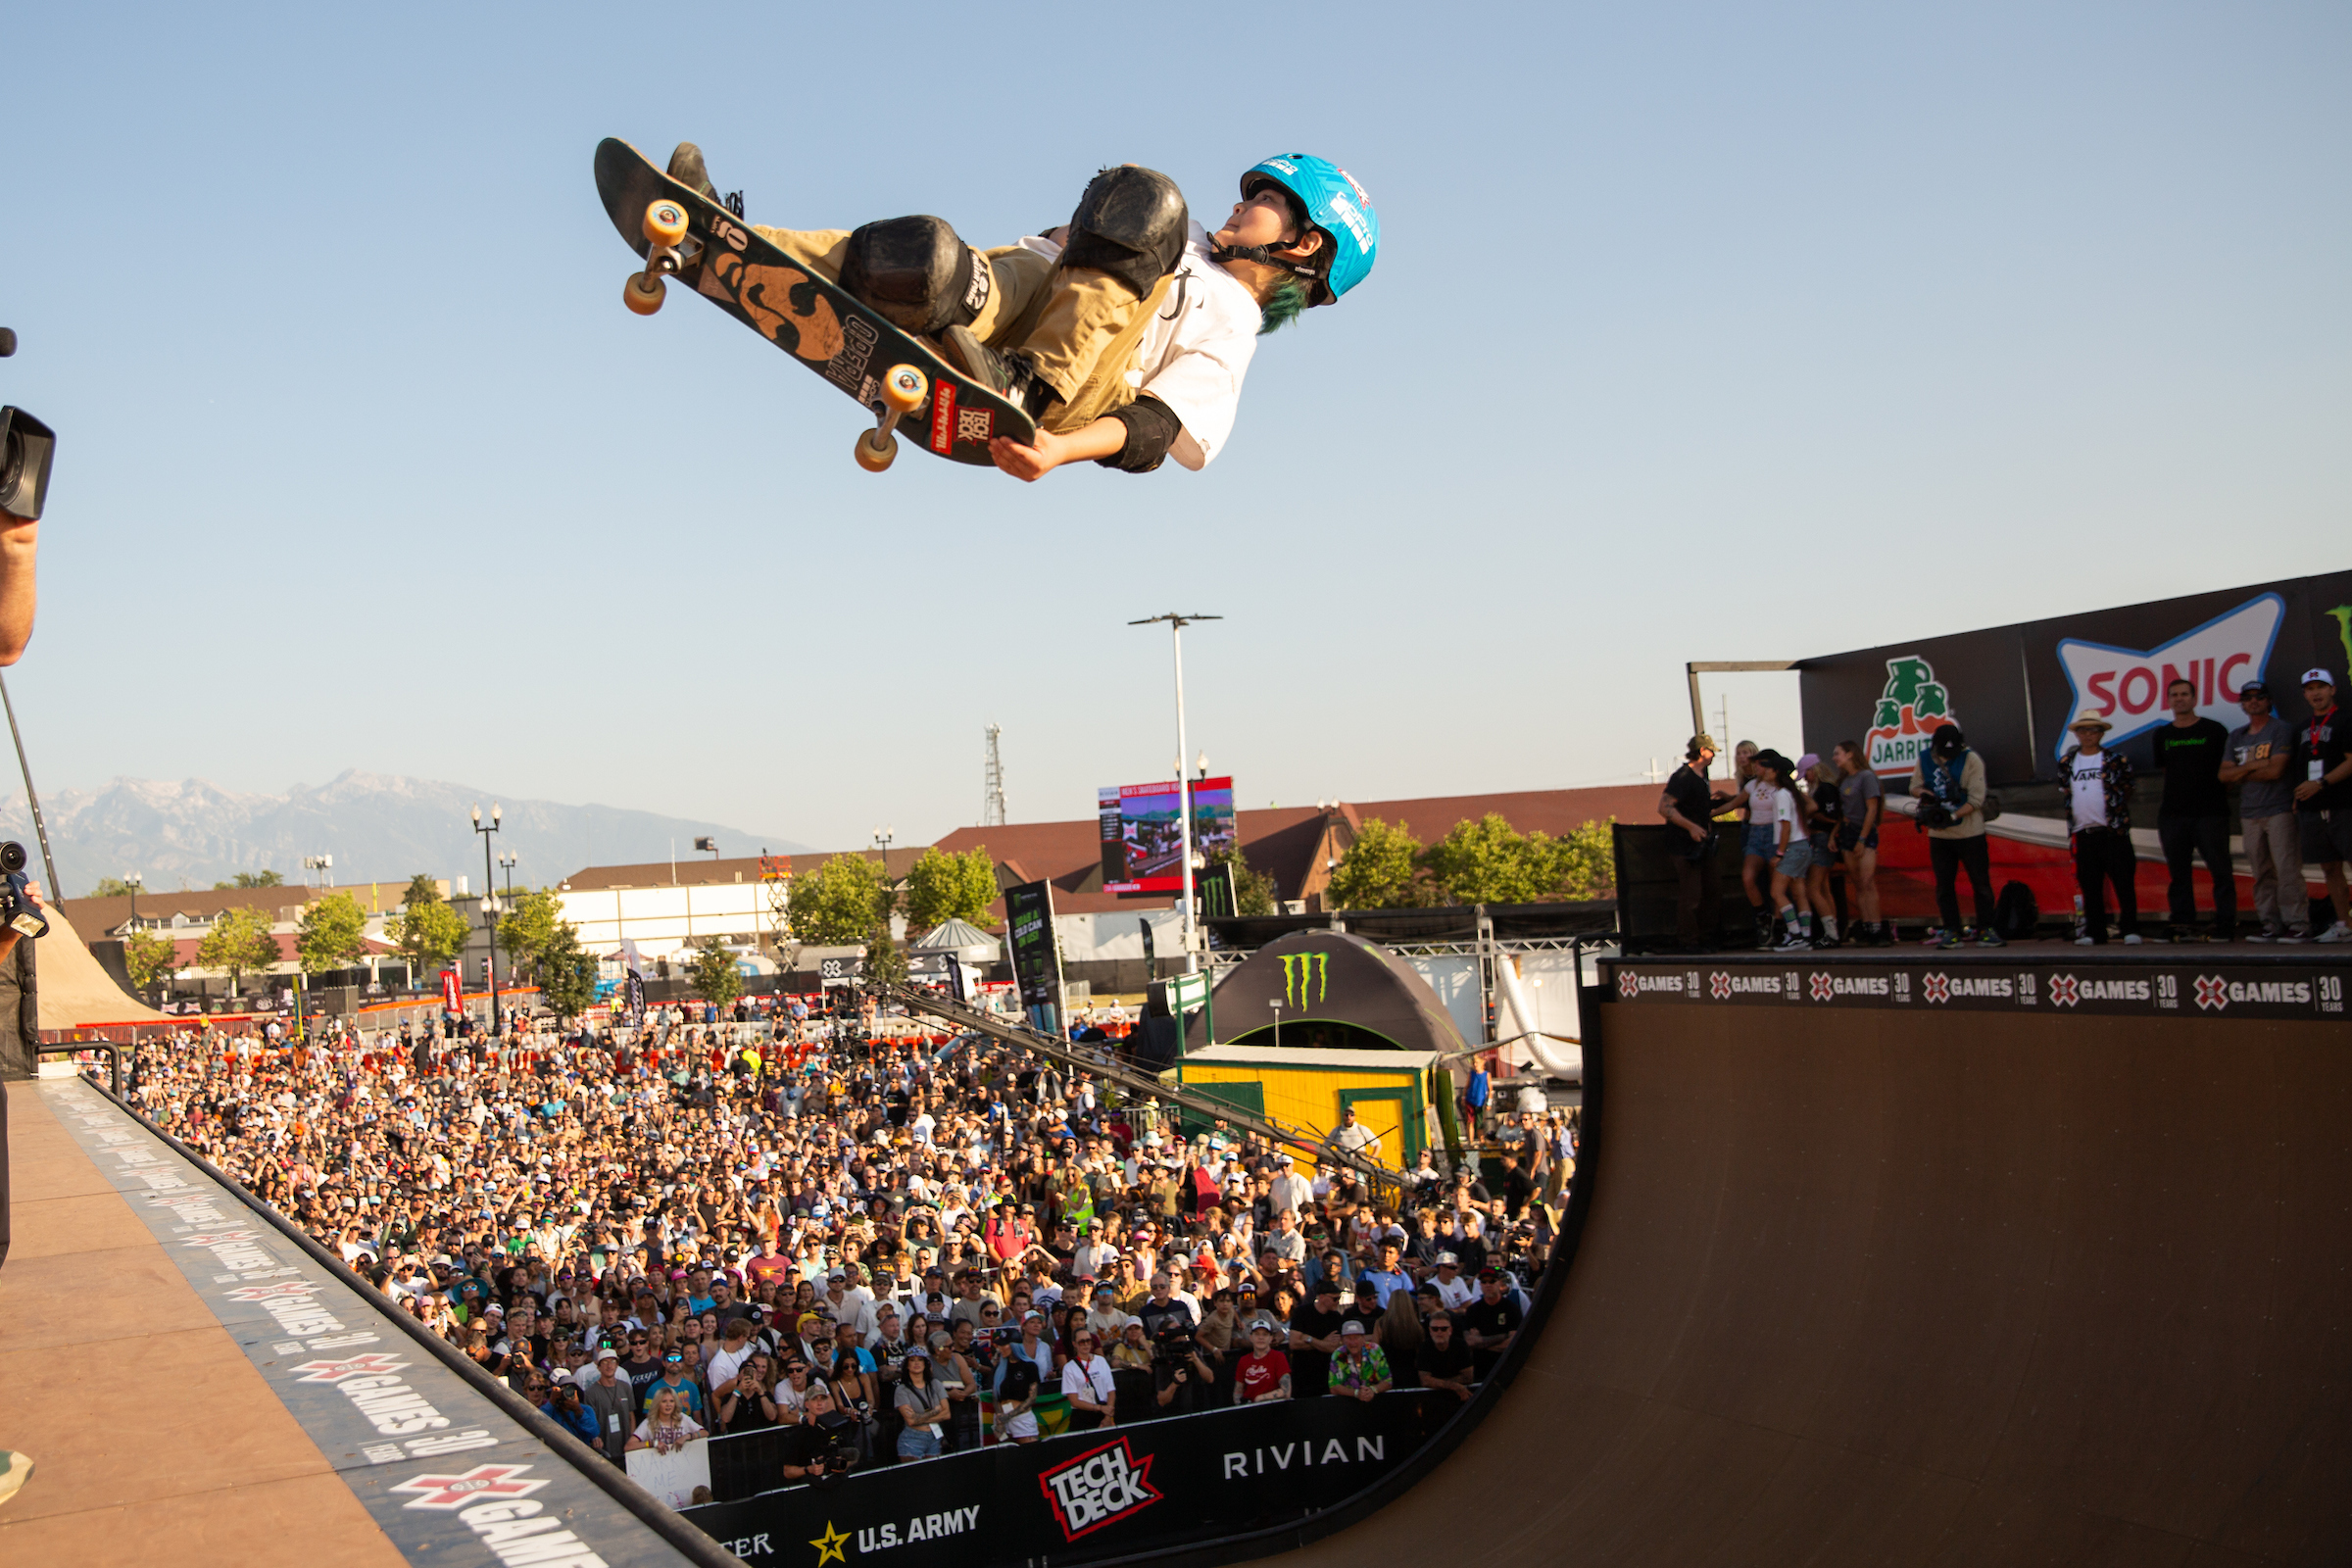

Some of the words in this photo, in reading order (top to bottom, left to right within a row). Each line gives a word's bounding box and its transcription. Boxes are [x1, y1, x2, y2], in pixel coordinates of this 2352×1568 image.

[825, 315, 879, 391] OPERA
[957, 410, 974, 441] DECK
[973, 412, 991, 441] TECH
[2084, 653, 2252, 717] SONIC
[1872, 738, 1933, 763] JARRIT
[1638, 976, 1683, 992] GAMES
[1687, 971, 1700, 990] 30
[1731, 976, 1781, 994] GAMES
[1785, 972, 1799, 992] 30
[1833, 977, 1888, 995] GAMES
[1894, 972, 1909, 993] 30
[1949, 978, 2012, 997] GAMES
[2018, 973, 2035, 996] 30
[2079, 980, 2150, 1000] GAMES
[2157, 974, 2178, 999] 30
[2228, 982, 2311, 1004] GAMES
[2319, 976, 2341, 1002] 30
[260, 1296, 346, 1336] GAMES
[337, 1375, 450, 1435] GAMES
[1224, 1435, 1385, 1480] RIVIAN
[1049, 1446, 1129, 1506] TECH
[1066, 1469, 1149, 1531] DECK
[858, 1523, 904, 1553] U.S.
[907, 1504, 980, 1544] ARMY
